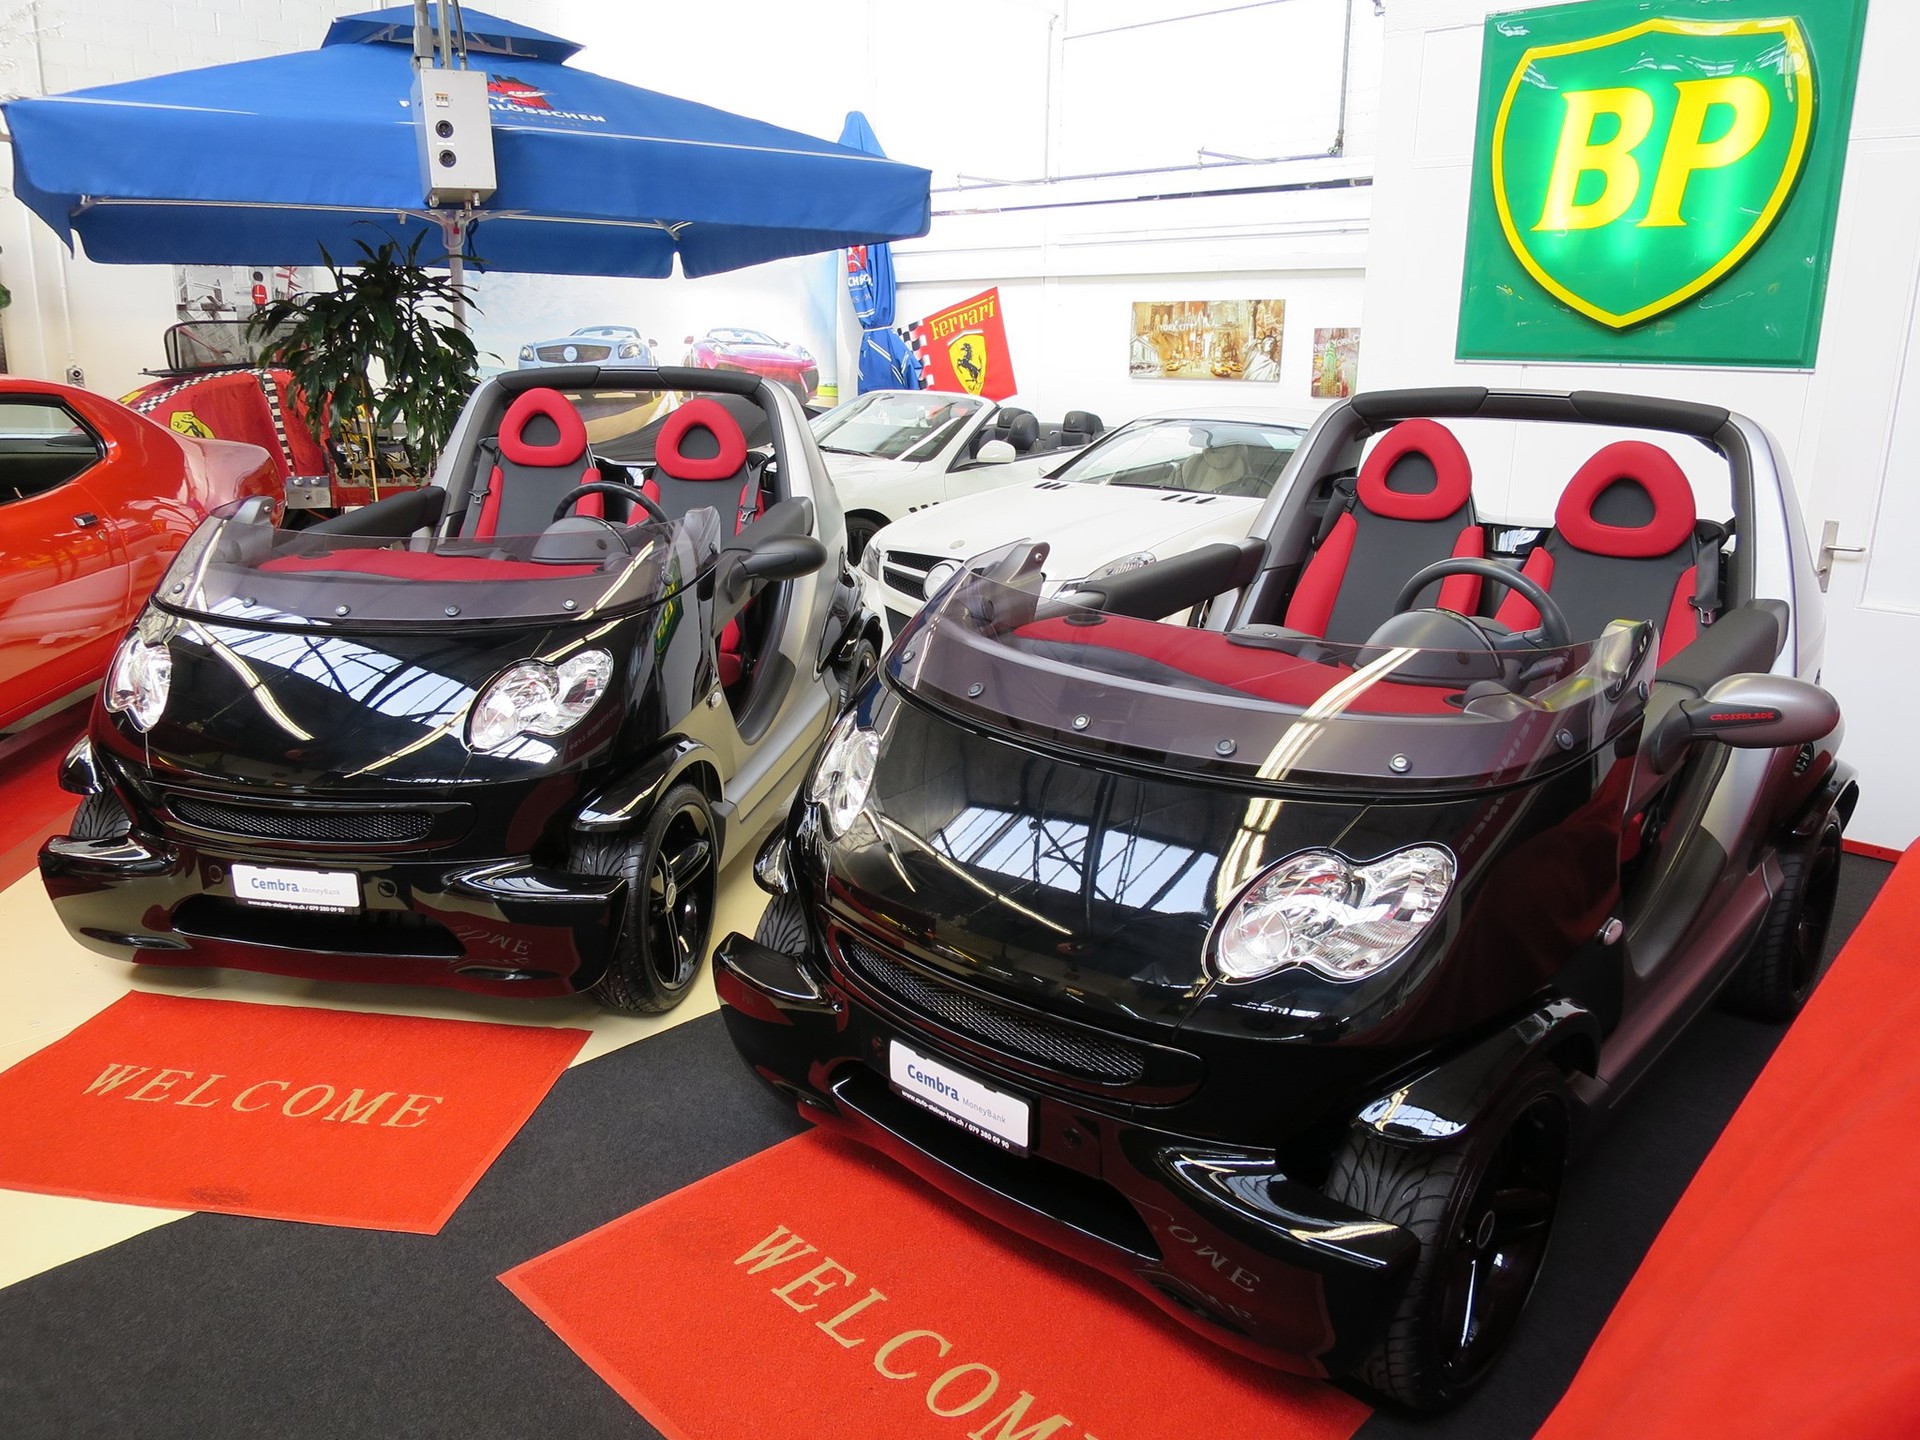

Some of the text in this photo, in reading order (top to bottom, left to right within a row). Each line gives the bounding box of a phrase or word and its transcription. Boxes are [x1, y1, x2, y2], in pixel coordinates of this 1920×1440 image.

[1530, 76, 1771, 231] BP
[929, 295, 995, 341] Ferrari
[1159, 323, 1178, 331] YORK
[1179, 322, 1195, 330] CITY
[1331, 337, 1353, 348] YORK
[1710, 711, 1775, 721] CROSSBLADE
[251, 877, 341, 896] Cembra MoneyBank
[81, 1063, 444, 1128] WELCOME
[907, 1063, 1006, 1125] Cembra MoneyBank
[968, 1124, 980, 1135] 079
[992, 1135, 1001, 1145] 09
[1001, 1140, 1010, 1149] 90
[733, 1224, 1099, 1440] WELCOM
